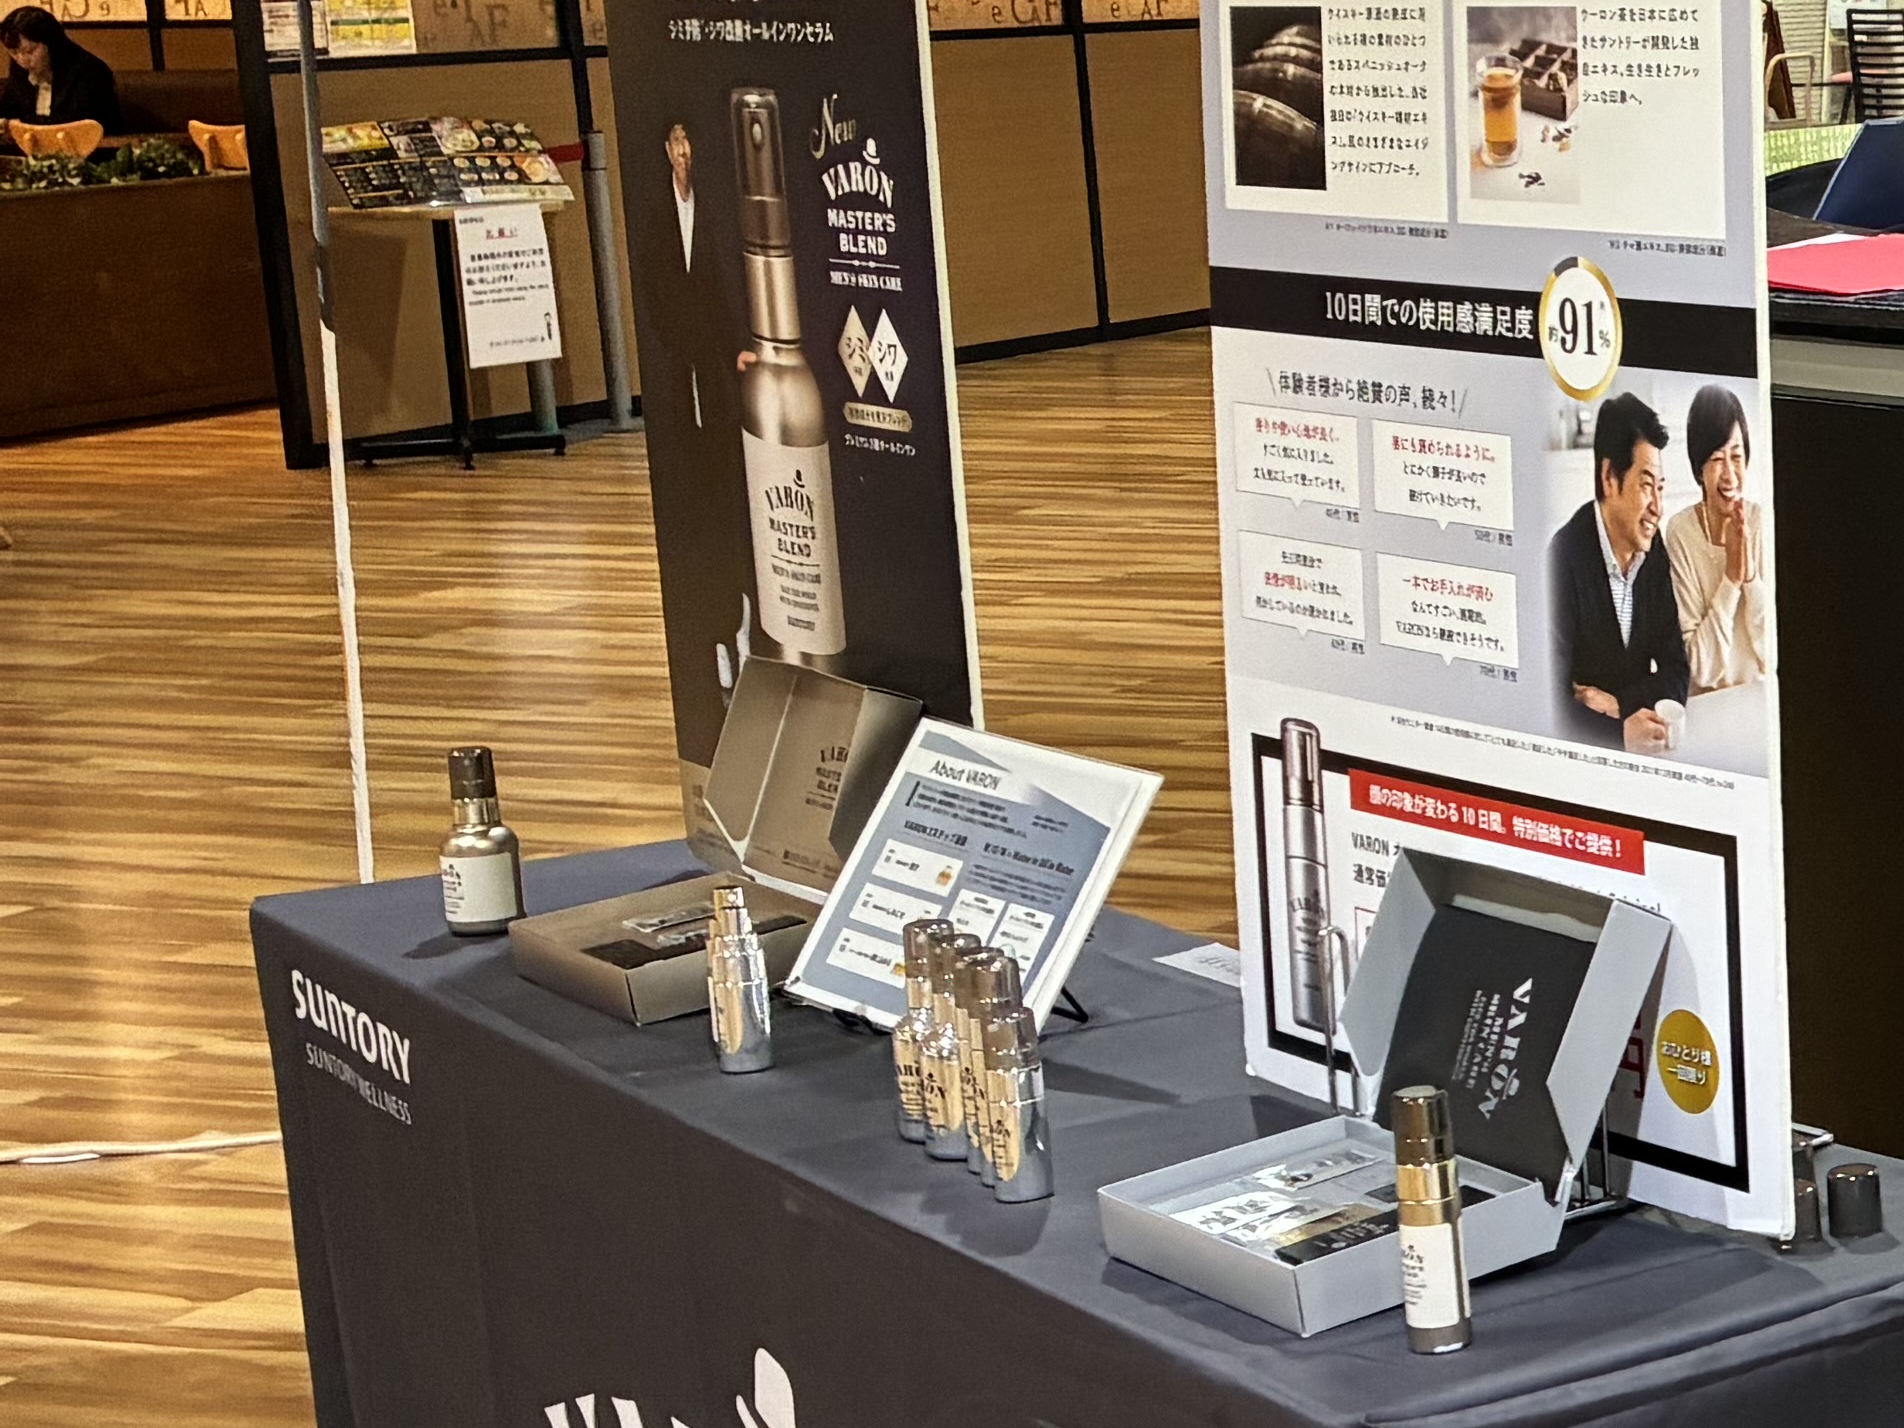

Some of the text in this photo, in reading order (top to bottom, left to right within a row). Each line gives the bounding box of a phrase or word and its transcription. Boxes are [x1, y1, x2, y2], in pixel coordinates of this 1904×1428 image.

[821, 159, 895, 209] VARON
[827, 207, 896, 233] MASTER'S
[839, 233, 888, 257] BLEND
[1351, 832, 1390, 856] VARON
[291, 967, 412, 1087] SUNTORY
